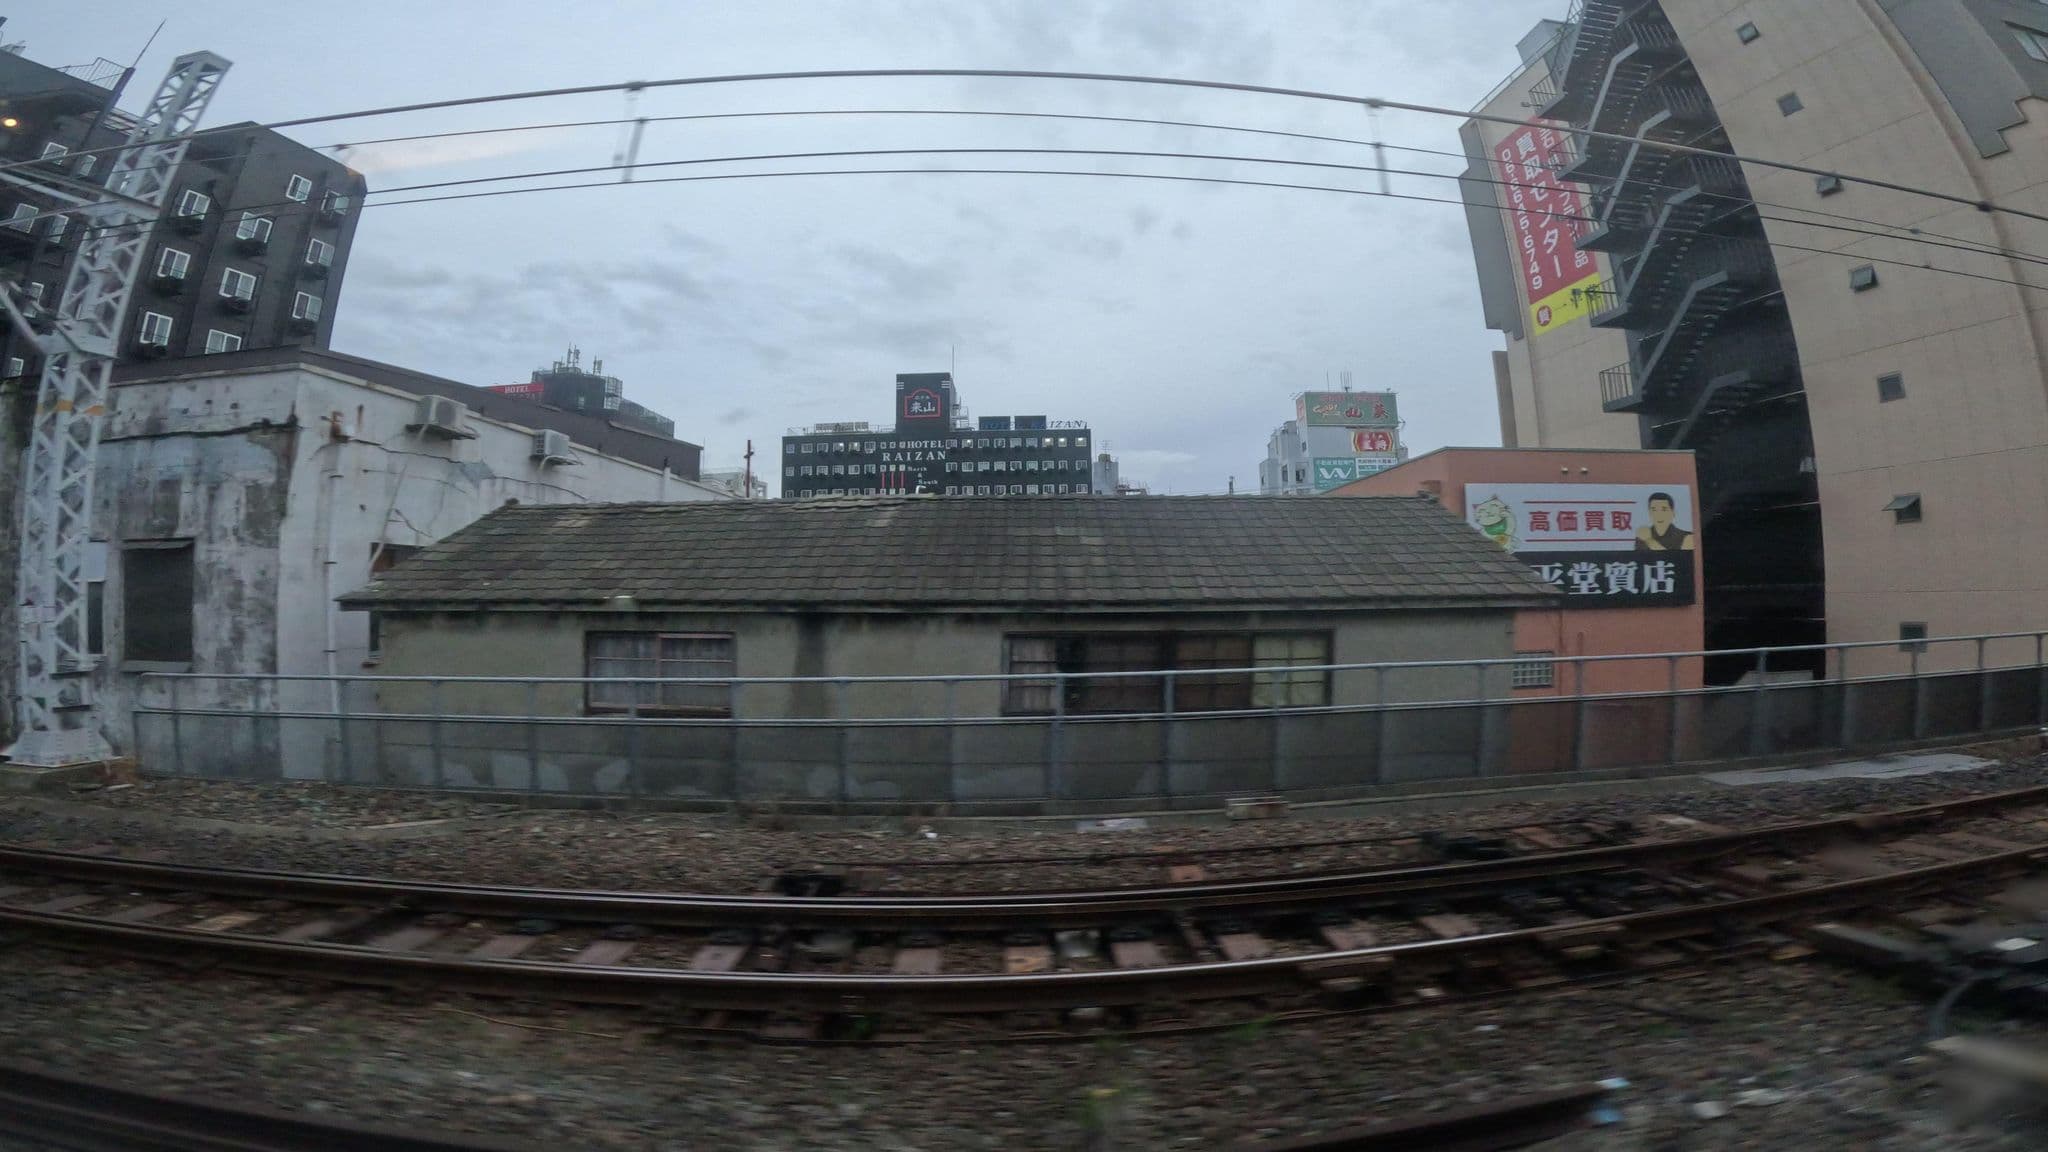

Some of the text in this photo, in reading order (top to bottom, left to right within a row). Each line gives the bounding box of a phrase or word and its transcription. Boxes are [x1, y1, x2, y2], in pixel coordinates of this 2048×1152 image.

[1515, 131, 1562, 278] 買取センター
[907, 440, 945, 449] HOTEL
[882, 450, 946, 461] RAIZAN
[1528, 510, 1632, 532] 高価買取
